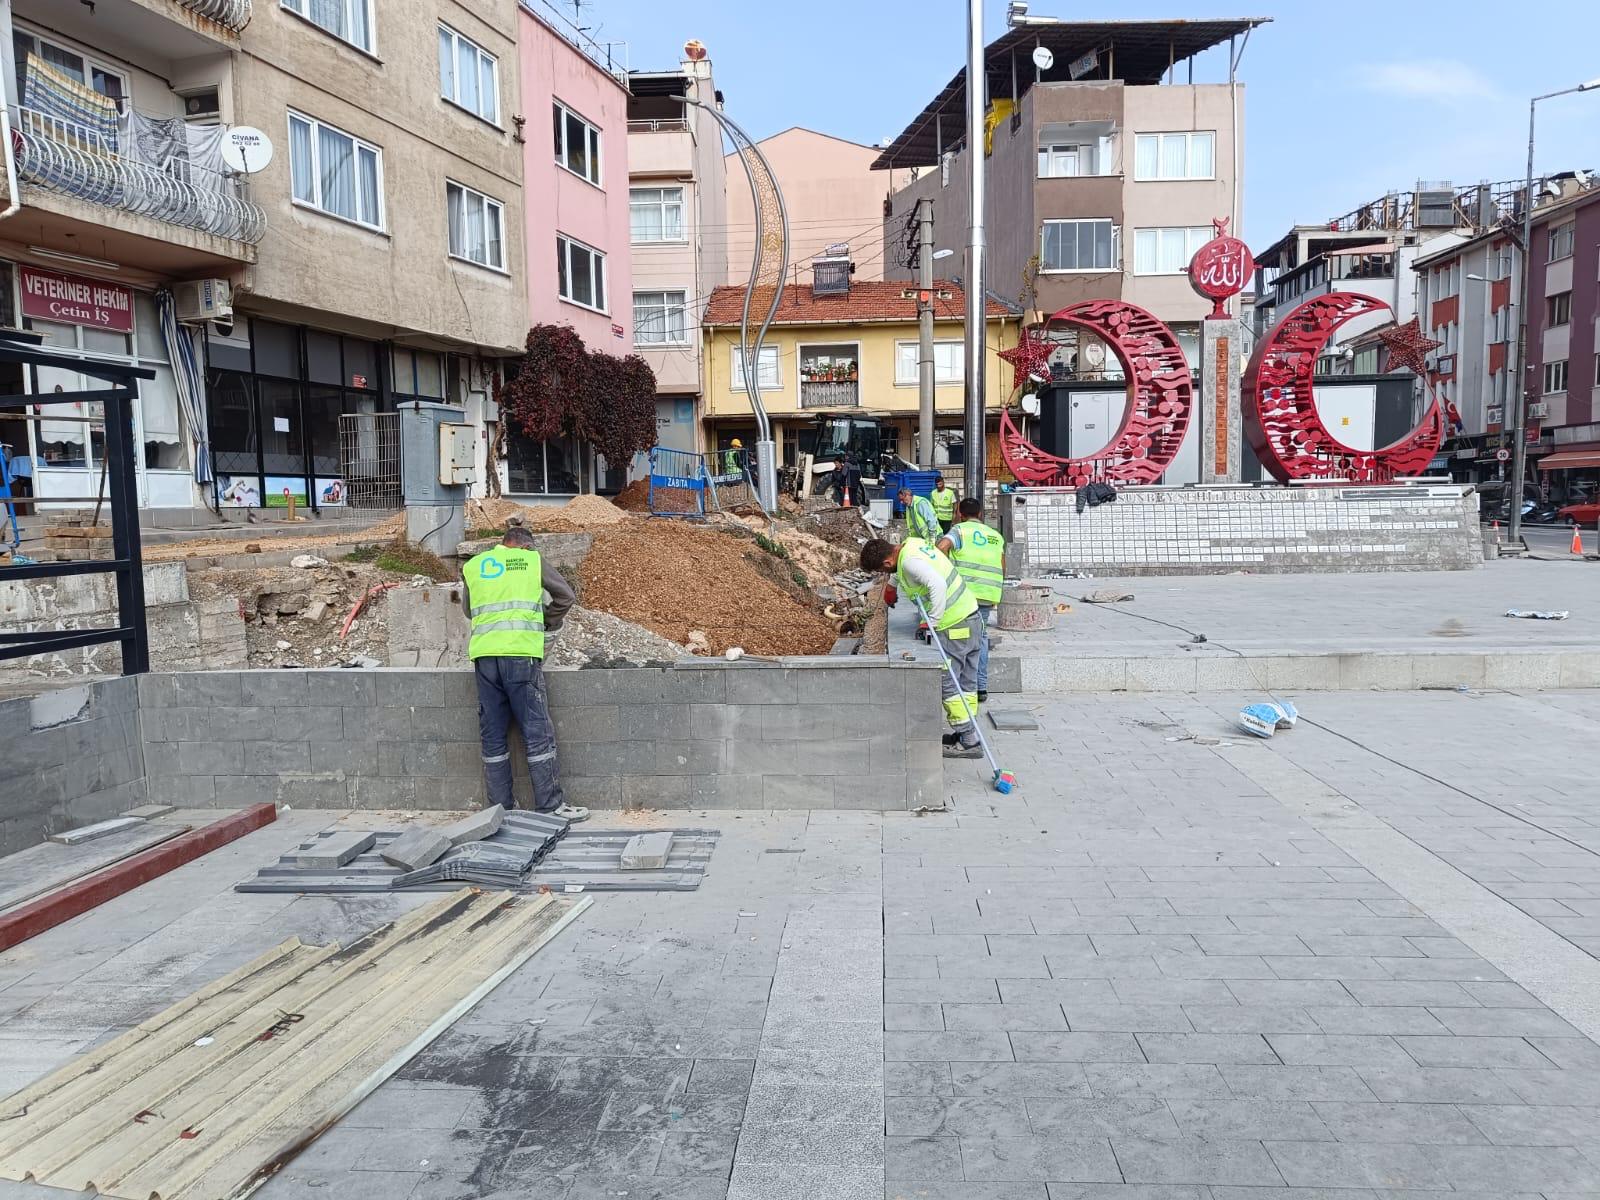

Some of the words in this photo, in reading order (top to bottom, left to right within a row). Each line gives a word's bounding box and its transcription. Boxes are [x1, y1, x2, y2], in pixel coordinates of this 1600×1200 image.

[24, 273, 92, 305] VETERİNER
[93, 287, 129, 311] HEKİM
[49, 302, 90, 319] Çetin
[95, 307, 110, 325] İŞ
[667, 477, 688, 488] ZABITA
